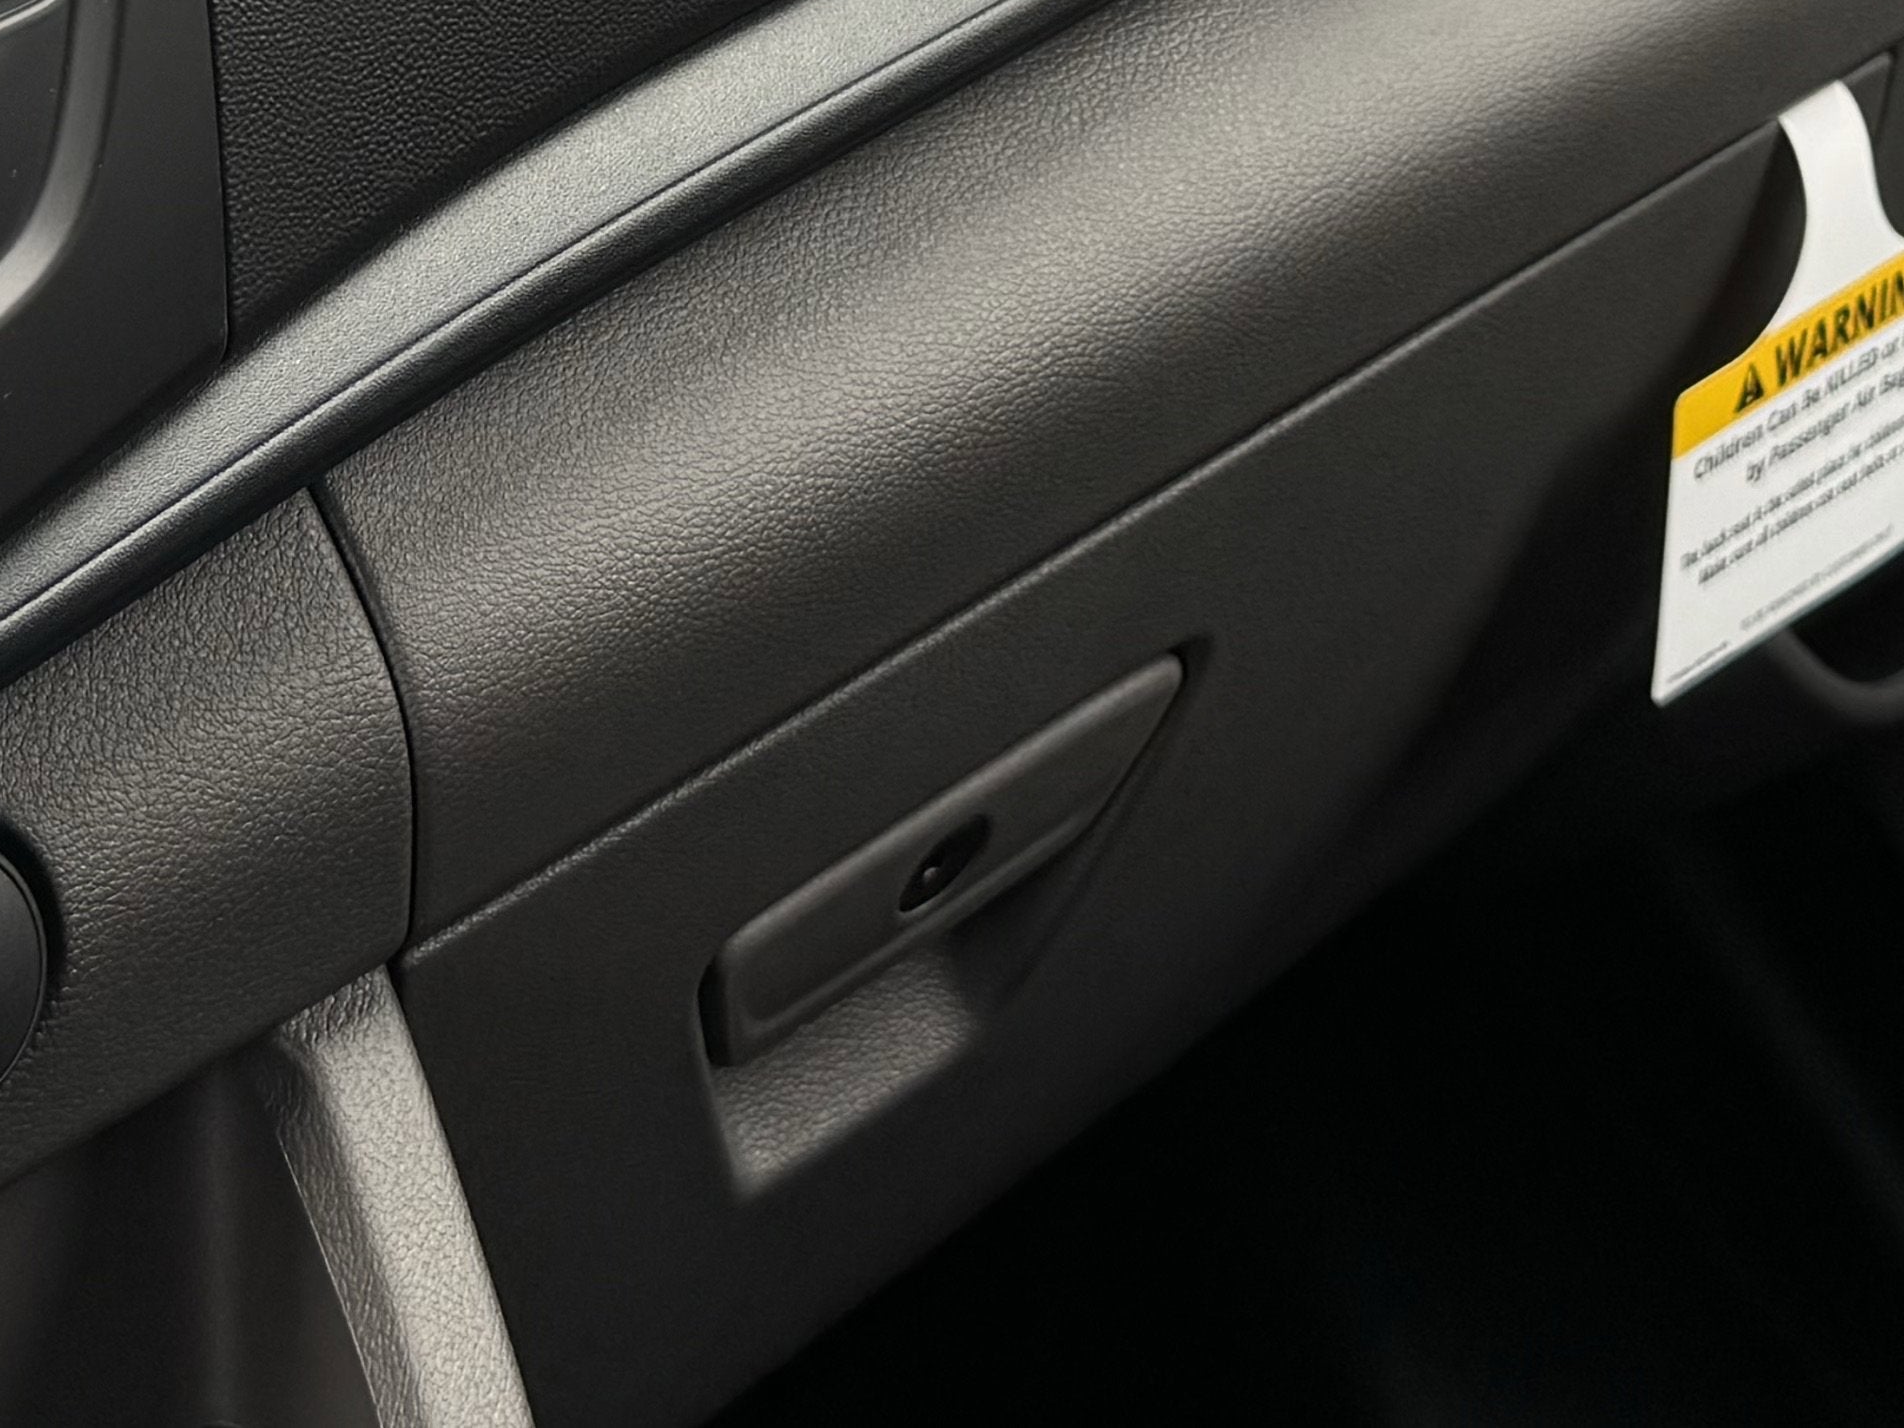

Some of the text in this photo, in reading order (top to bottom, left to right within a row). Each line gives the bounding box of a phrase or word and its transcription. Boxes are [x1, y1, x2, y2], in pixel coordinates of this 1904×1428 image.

[1693, 423, 1764, 479] Children
[1765, 400, 1796, 432] Can
[1802, 388, 1821, 412] Be
[1823, 350, 1880, 397] KILLED
[1746, 458, 1766, 484] by
[1769, 404, 1848, 465] Passenger
[1851, 385, 1876, 414] Air
